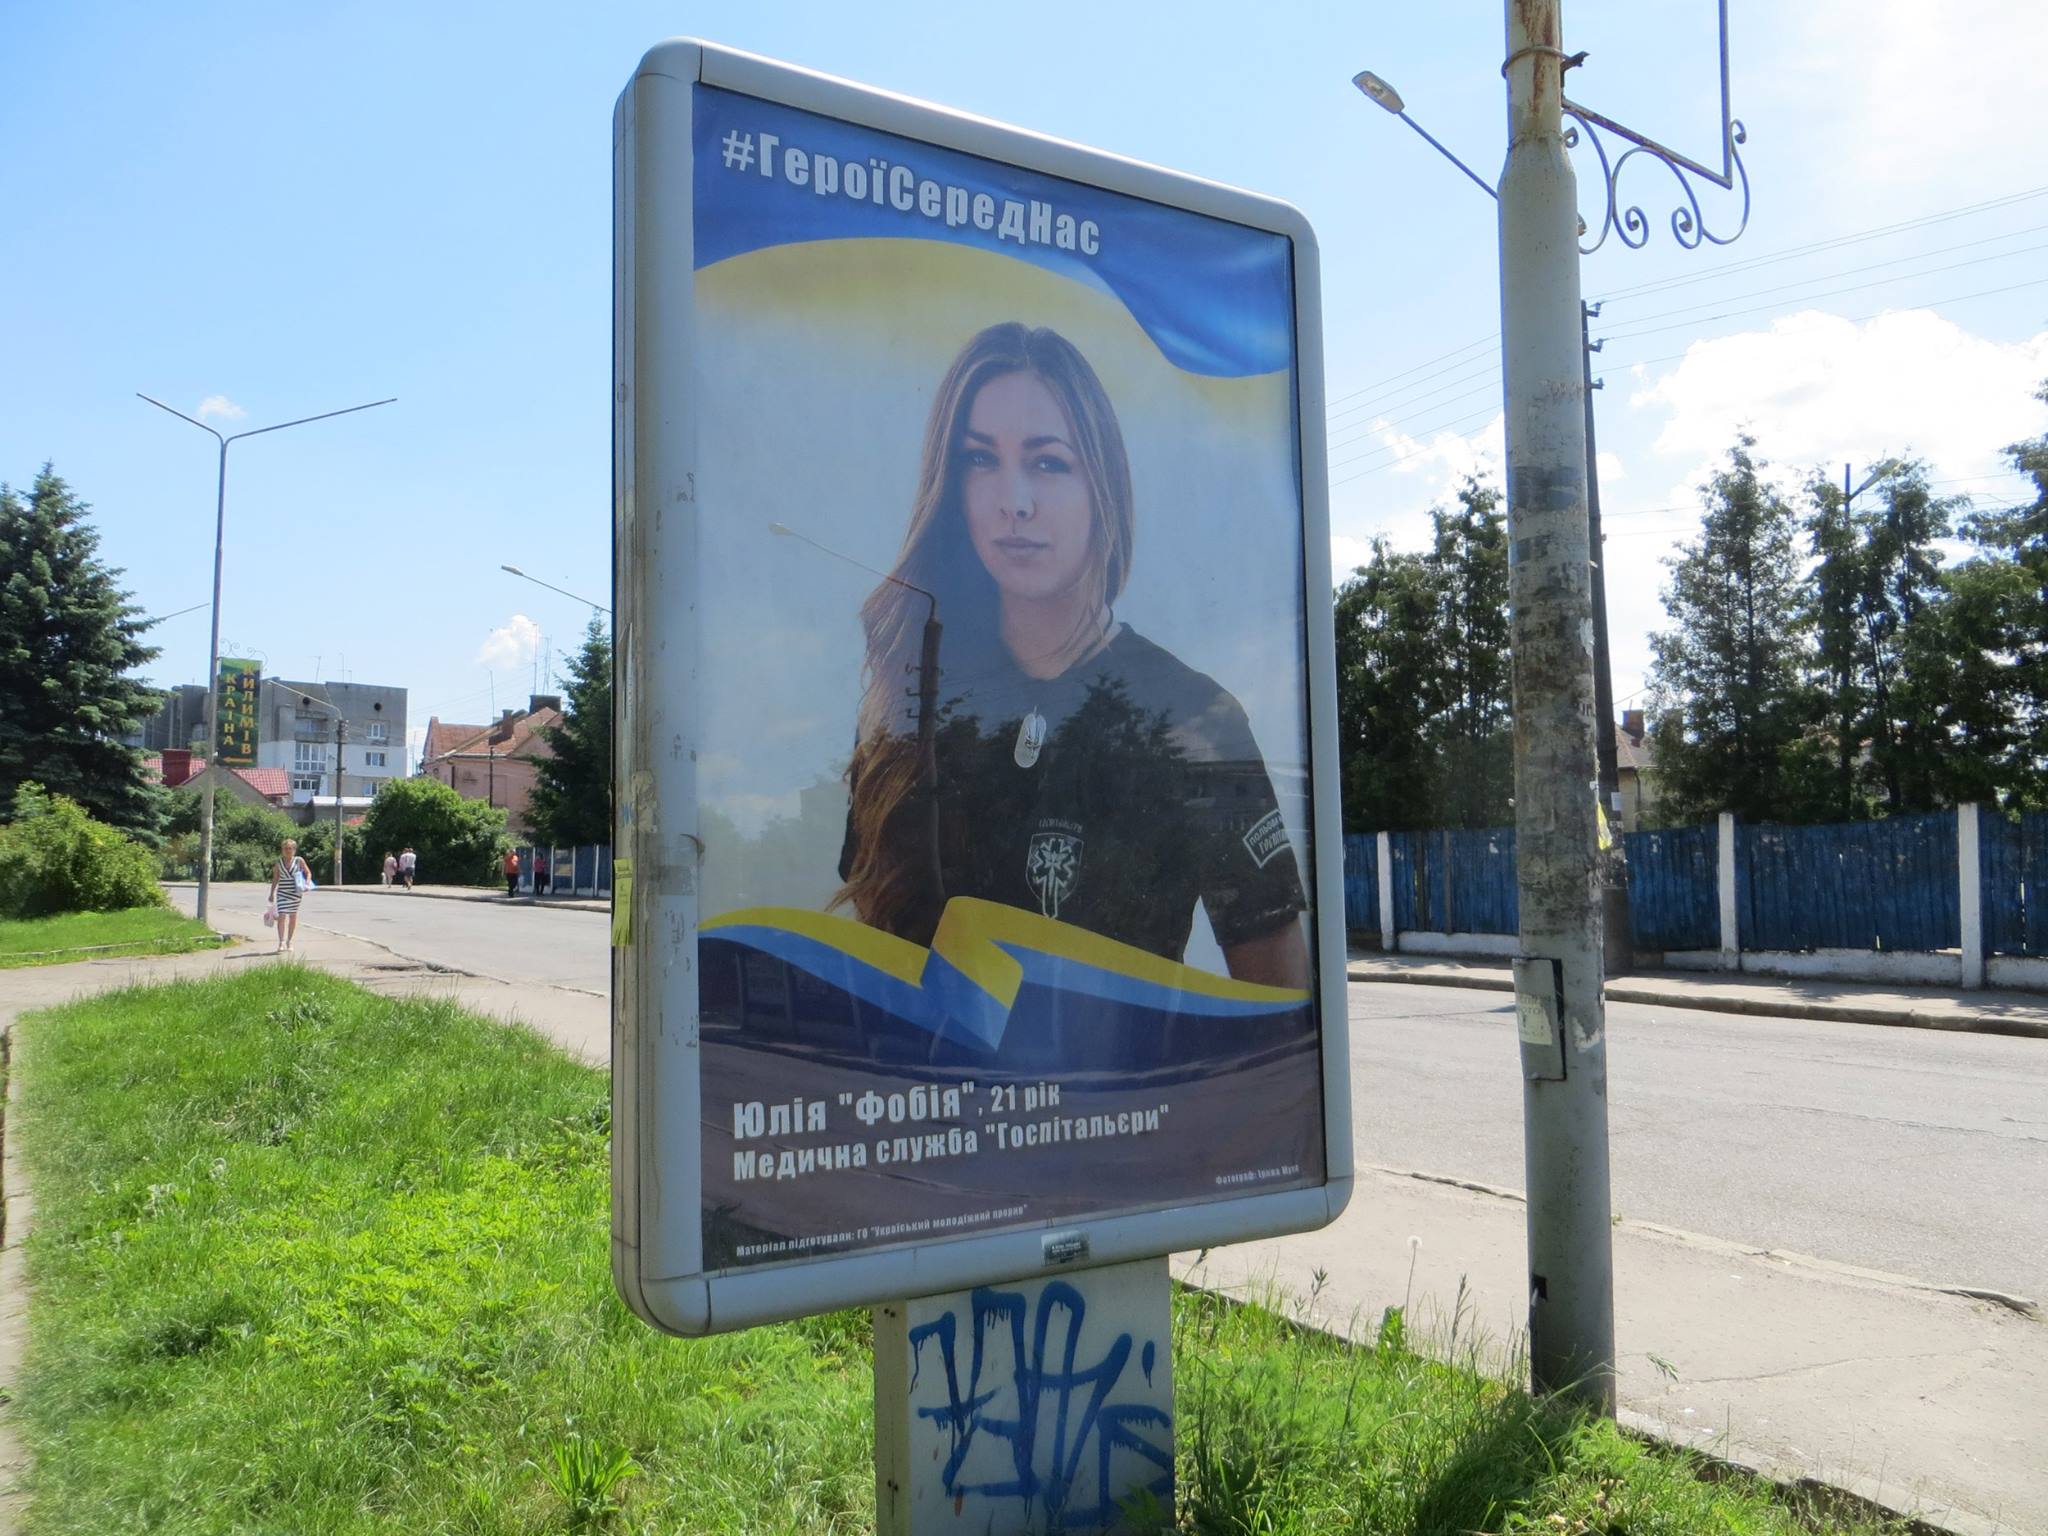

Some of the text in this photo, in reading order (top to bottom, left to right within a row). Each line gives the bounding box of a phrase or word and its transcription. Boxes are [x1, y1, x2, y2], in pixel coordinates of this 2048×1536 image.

[722, 129, 1100, 256] #ГероїСередНас
[240, 663, 255, 754] КИЛИМІВ
[734, 1096, 827, 1140] Юлія
[990, 1084, 1016, 1113] 21
[1024, 1081, 1060, 1112] рік
[734, 1104, 1169, 1181] Медична служба "Госпітальєри"
